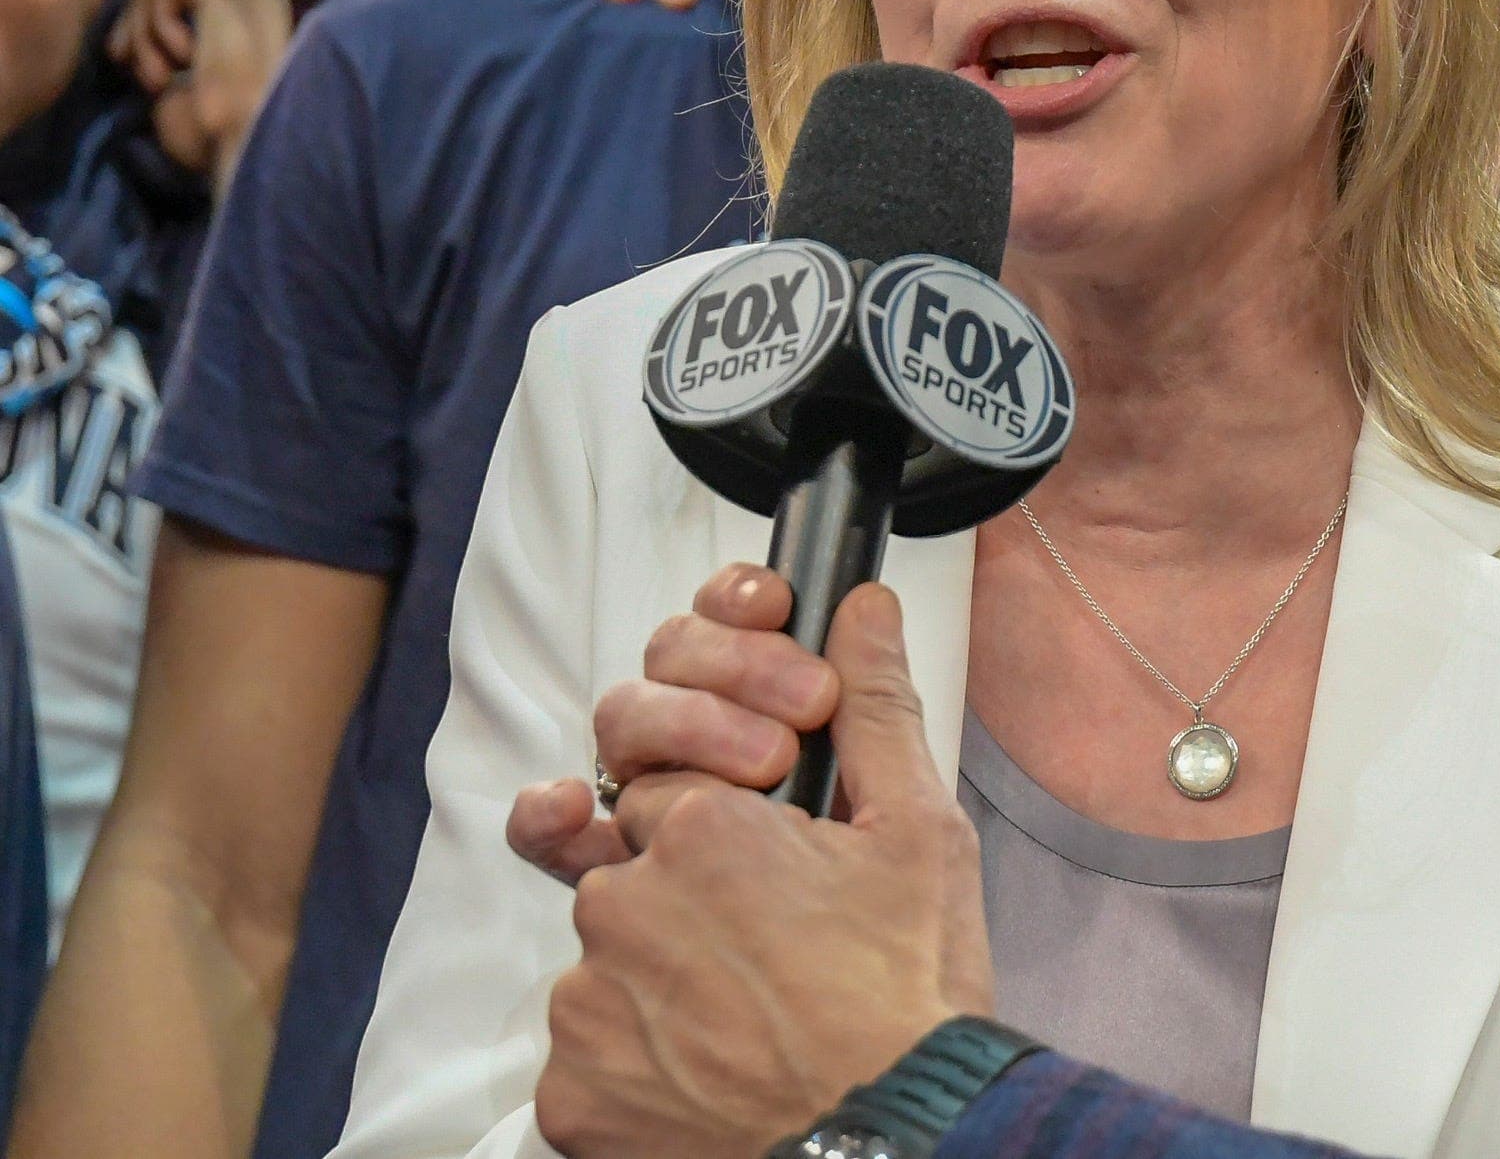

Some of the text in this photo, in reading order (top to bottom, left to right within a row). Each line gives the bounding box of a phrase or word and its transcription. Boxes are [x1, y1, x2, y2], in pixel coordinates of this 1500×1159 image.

[685, 267, 809, 365] FOX
[907, 281, 1034, 410] FOX
[678, 343, 799, 393] SPORTS
[901, 355, 1028, 440] SPORTS
